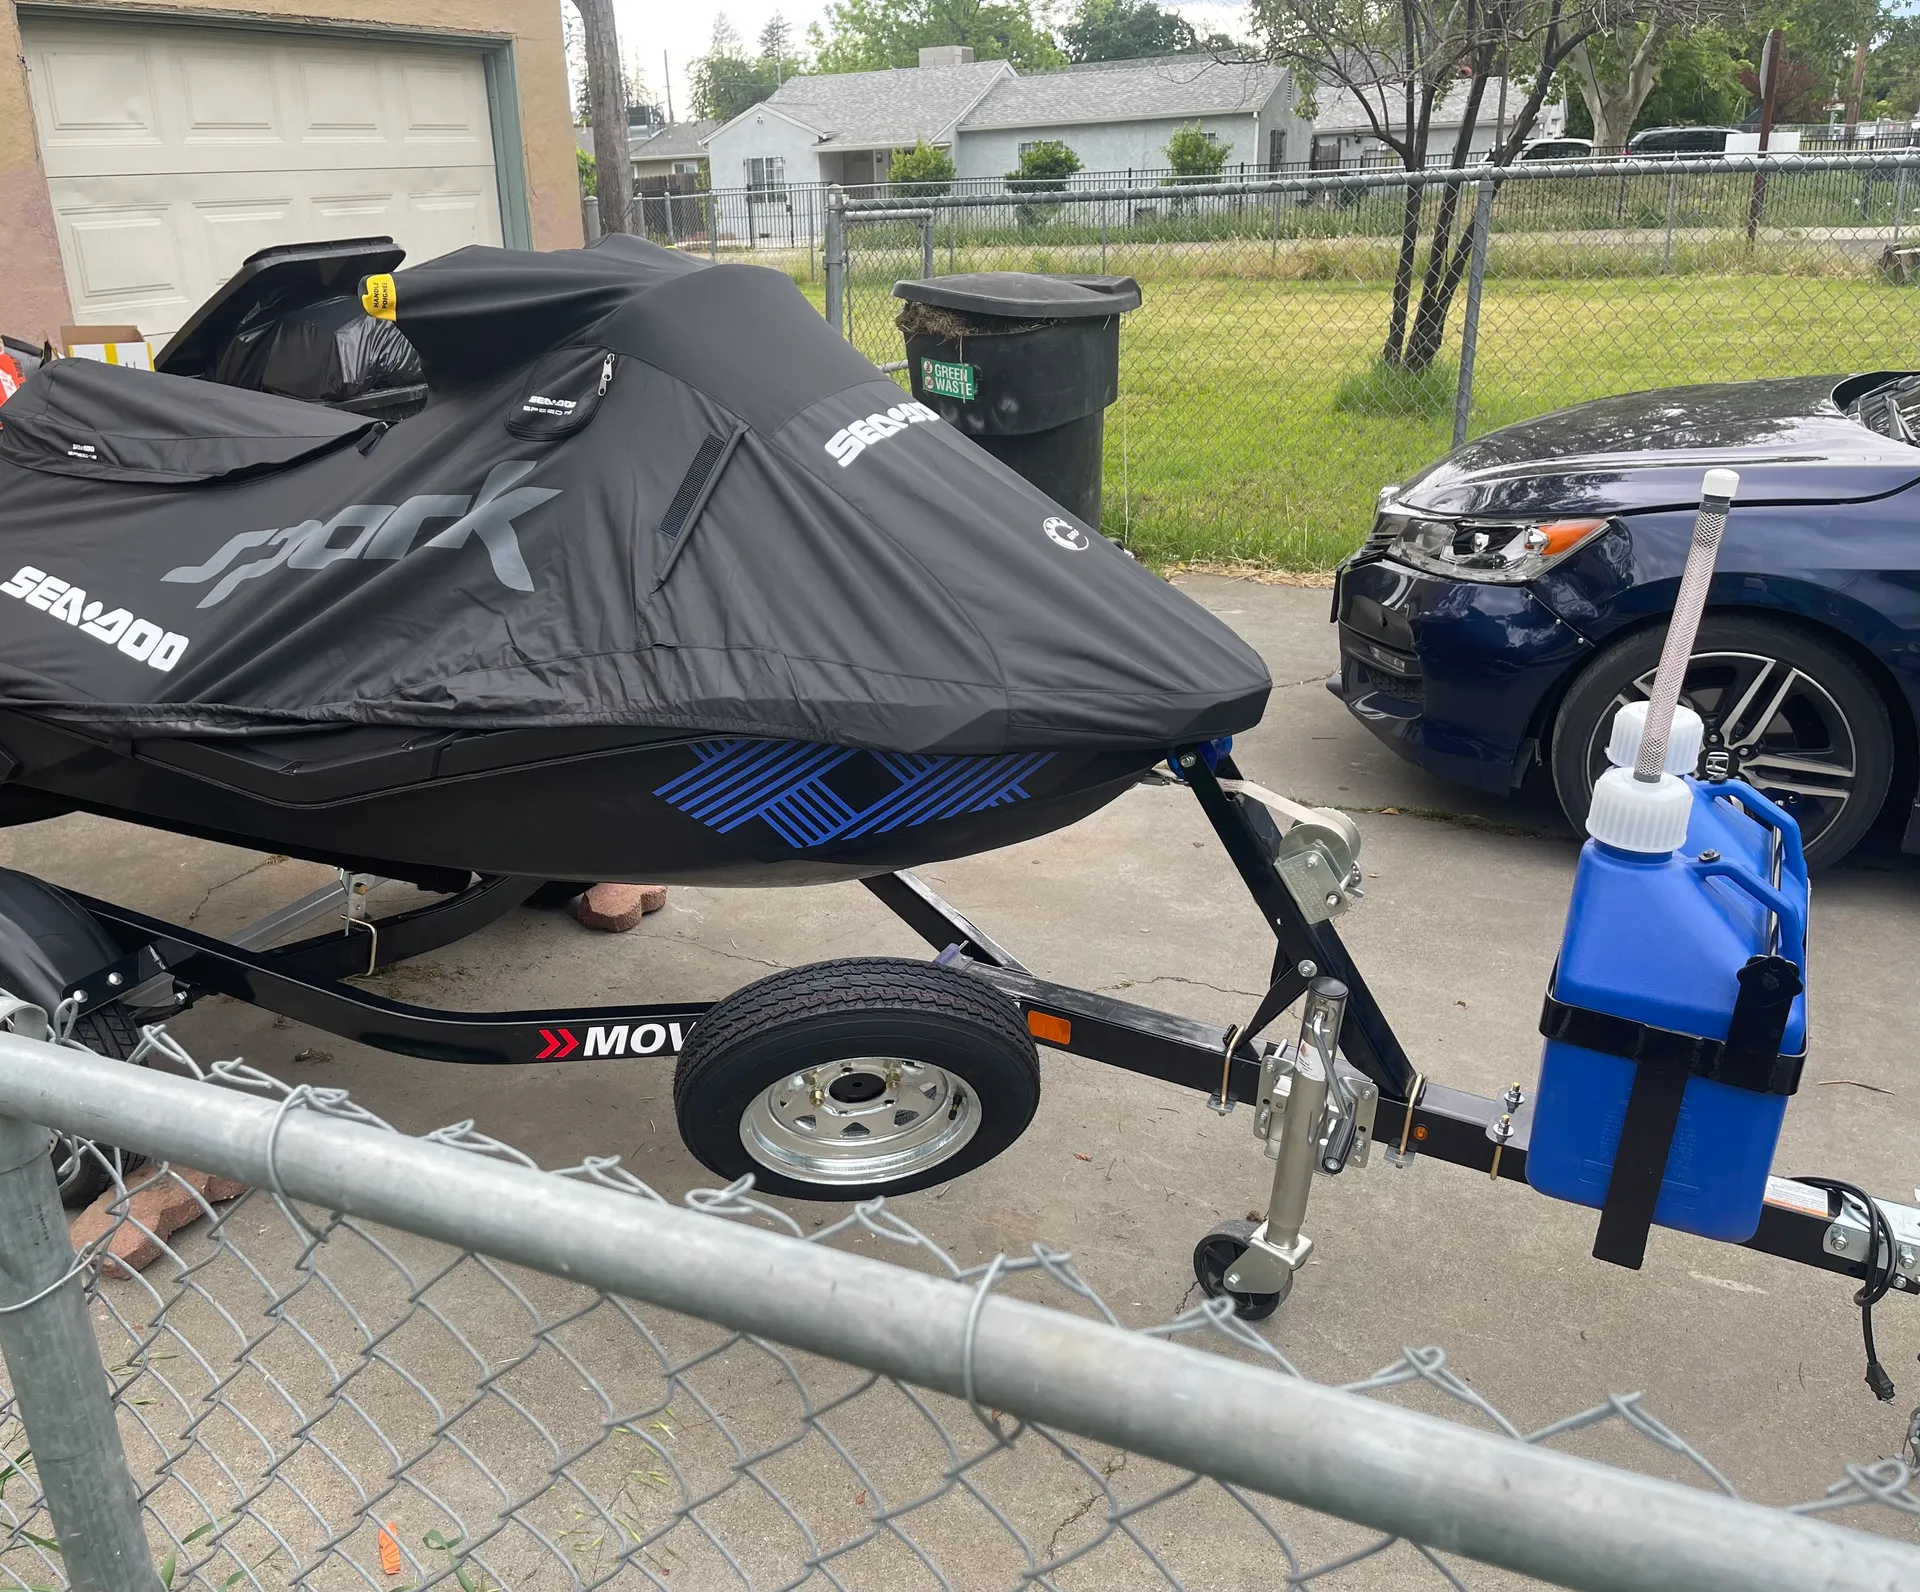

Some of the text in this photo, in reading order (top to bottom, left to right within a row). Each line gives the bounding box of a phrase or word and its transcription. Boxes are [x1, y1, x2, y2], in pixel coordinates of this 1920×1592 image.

[934, 363, 968, 382] GREEN
[934, 376, 973, 396] WASTE
[583, 1022, 697, 1057] MOV
